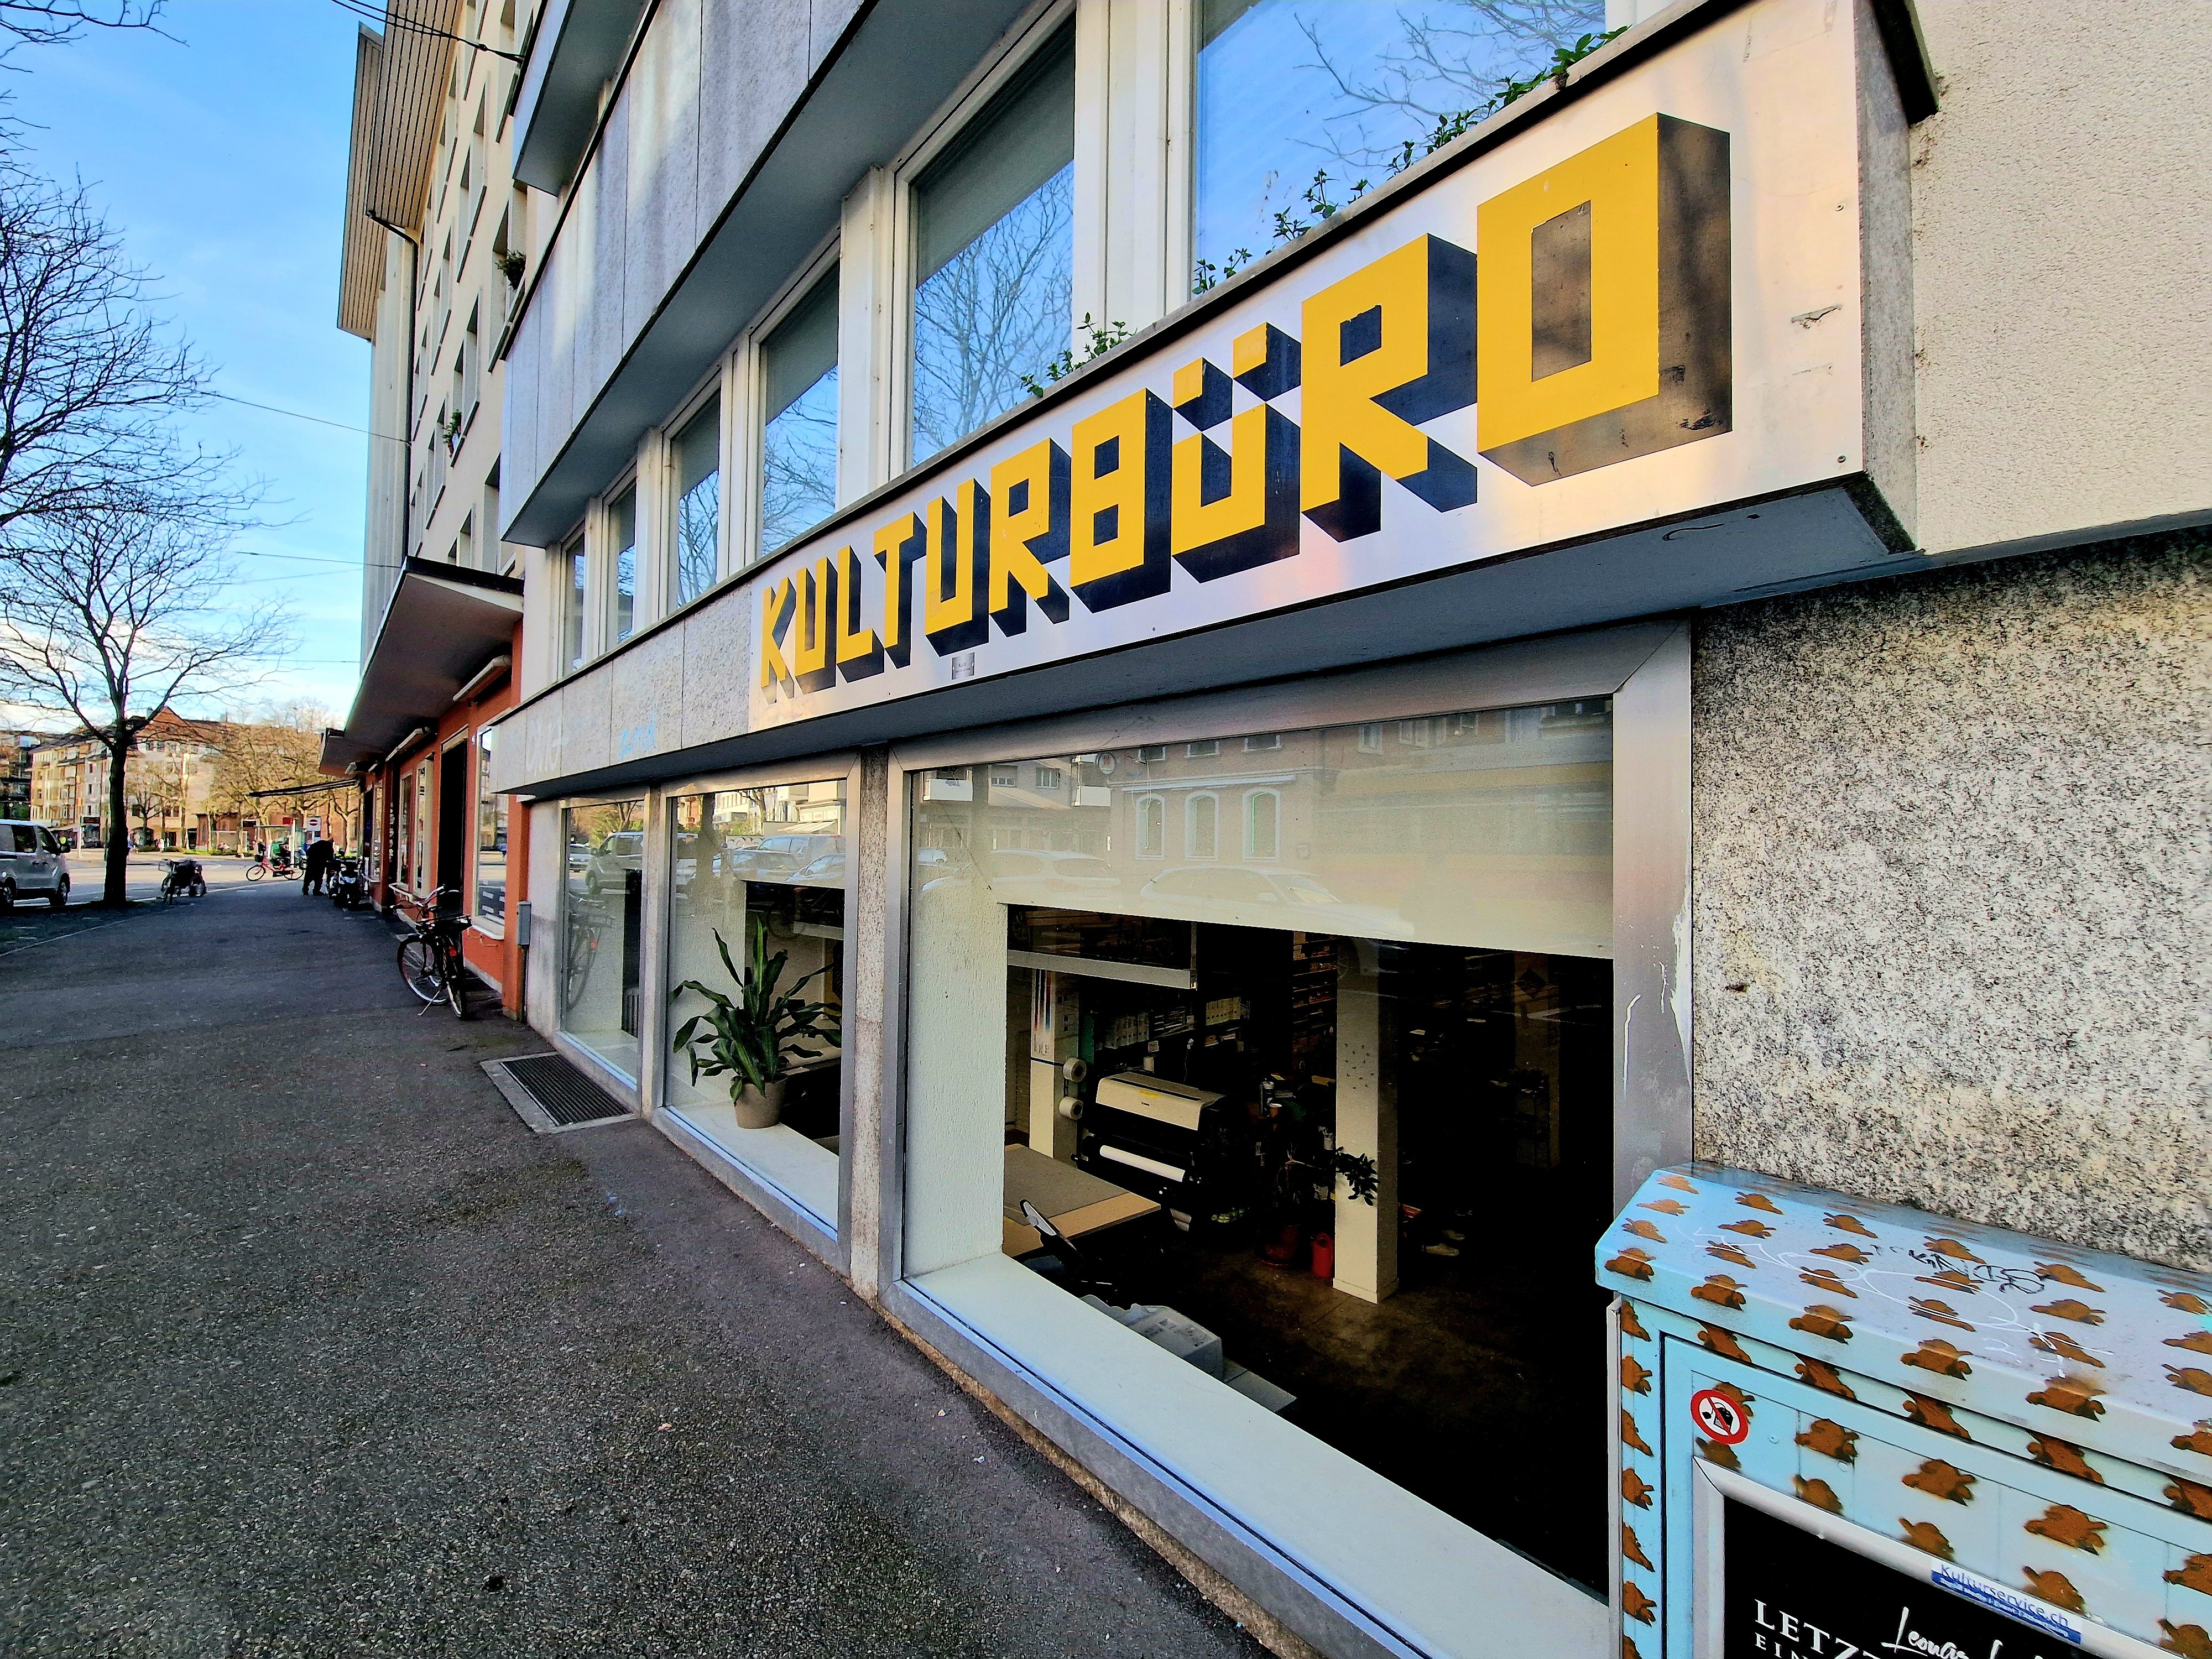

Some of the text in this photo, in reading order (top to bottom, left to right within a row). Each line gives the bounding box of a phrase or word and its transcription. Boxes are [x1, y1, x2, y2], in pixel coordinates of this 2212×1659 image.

[760, 113, 1731, 703] KULTURBÜRO
[1940, 1564, 2069, 1627] Kulturservice.ch
[1754, 1599, 1880, 1659] LETZ
